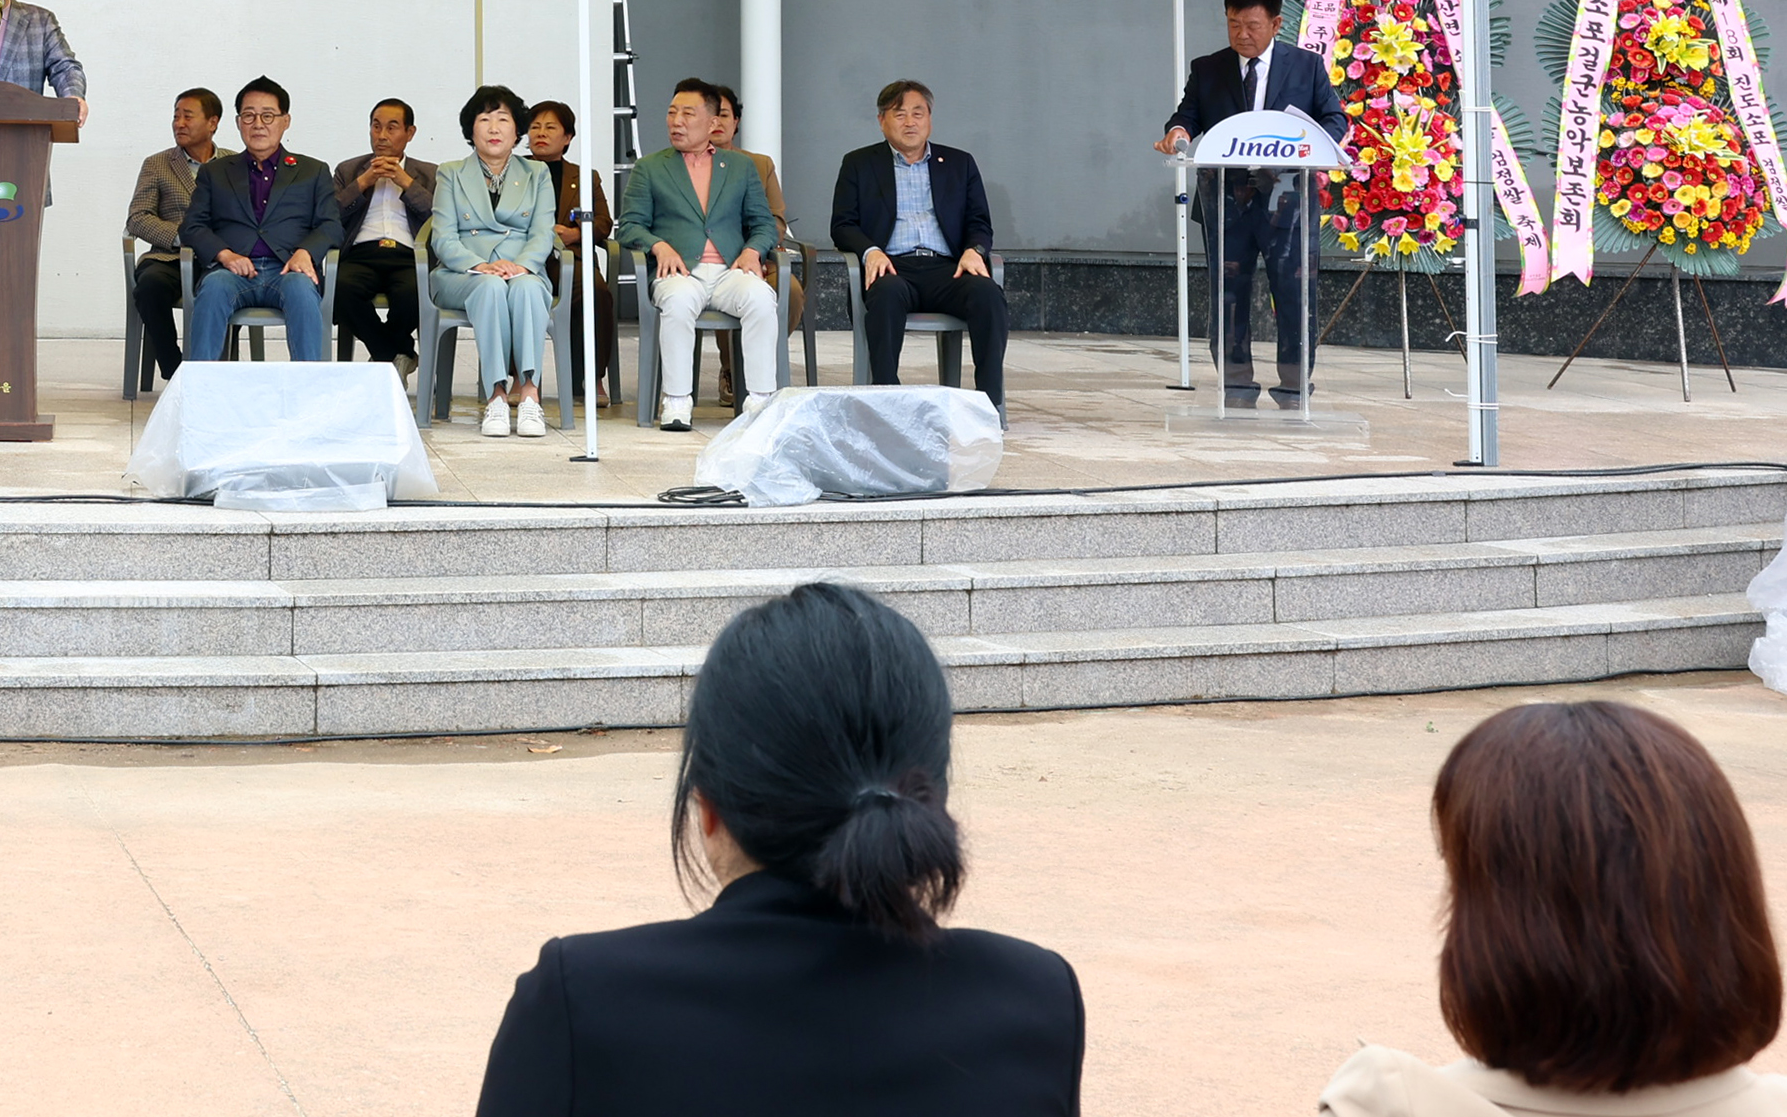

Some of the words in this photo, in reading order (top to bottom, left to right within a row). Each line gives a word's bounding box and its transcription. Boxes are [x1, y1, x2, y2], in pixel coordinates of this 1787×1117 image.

[1733, 73, 1772, 147] 진도소포
[1223, 137, 1296, 158] Jindo
[1517, 213, 1542, 251] 축제
